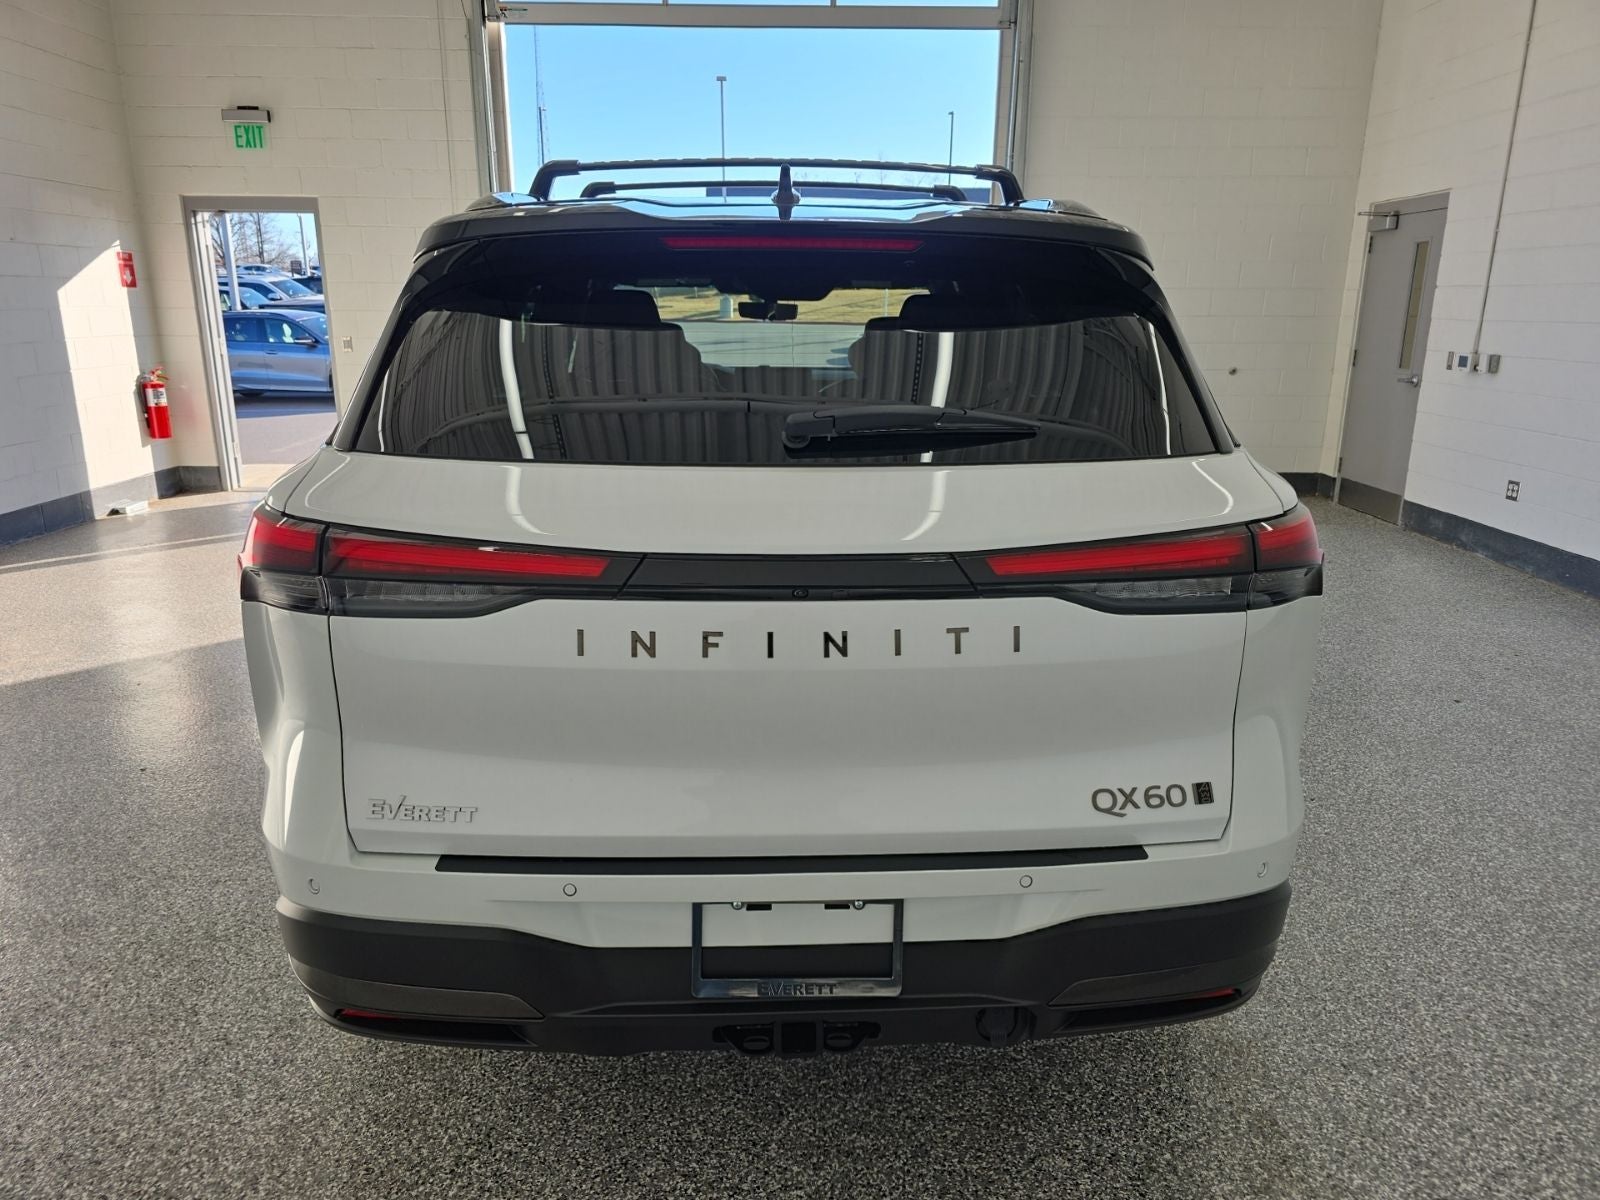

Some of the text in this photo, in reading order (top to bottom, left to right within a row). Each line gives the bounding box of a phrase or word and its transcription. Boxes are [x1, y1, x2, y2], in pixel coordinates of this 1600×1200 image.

[233, 124, 264, 149] EXIT
[576, 625, 1021, 658] INFINITI
[365, 794, 479, 823] EVERETT
[1091, 783, 1188, 818] QX60
[757, 981, 837, 996] EVERETT
